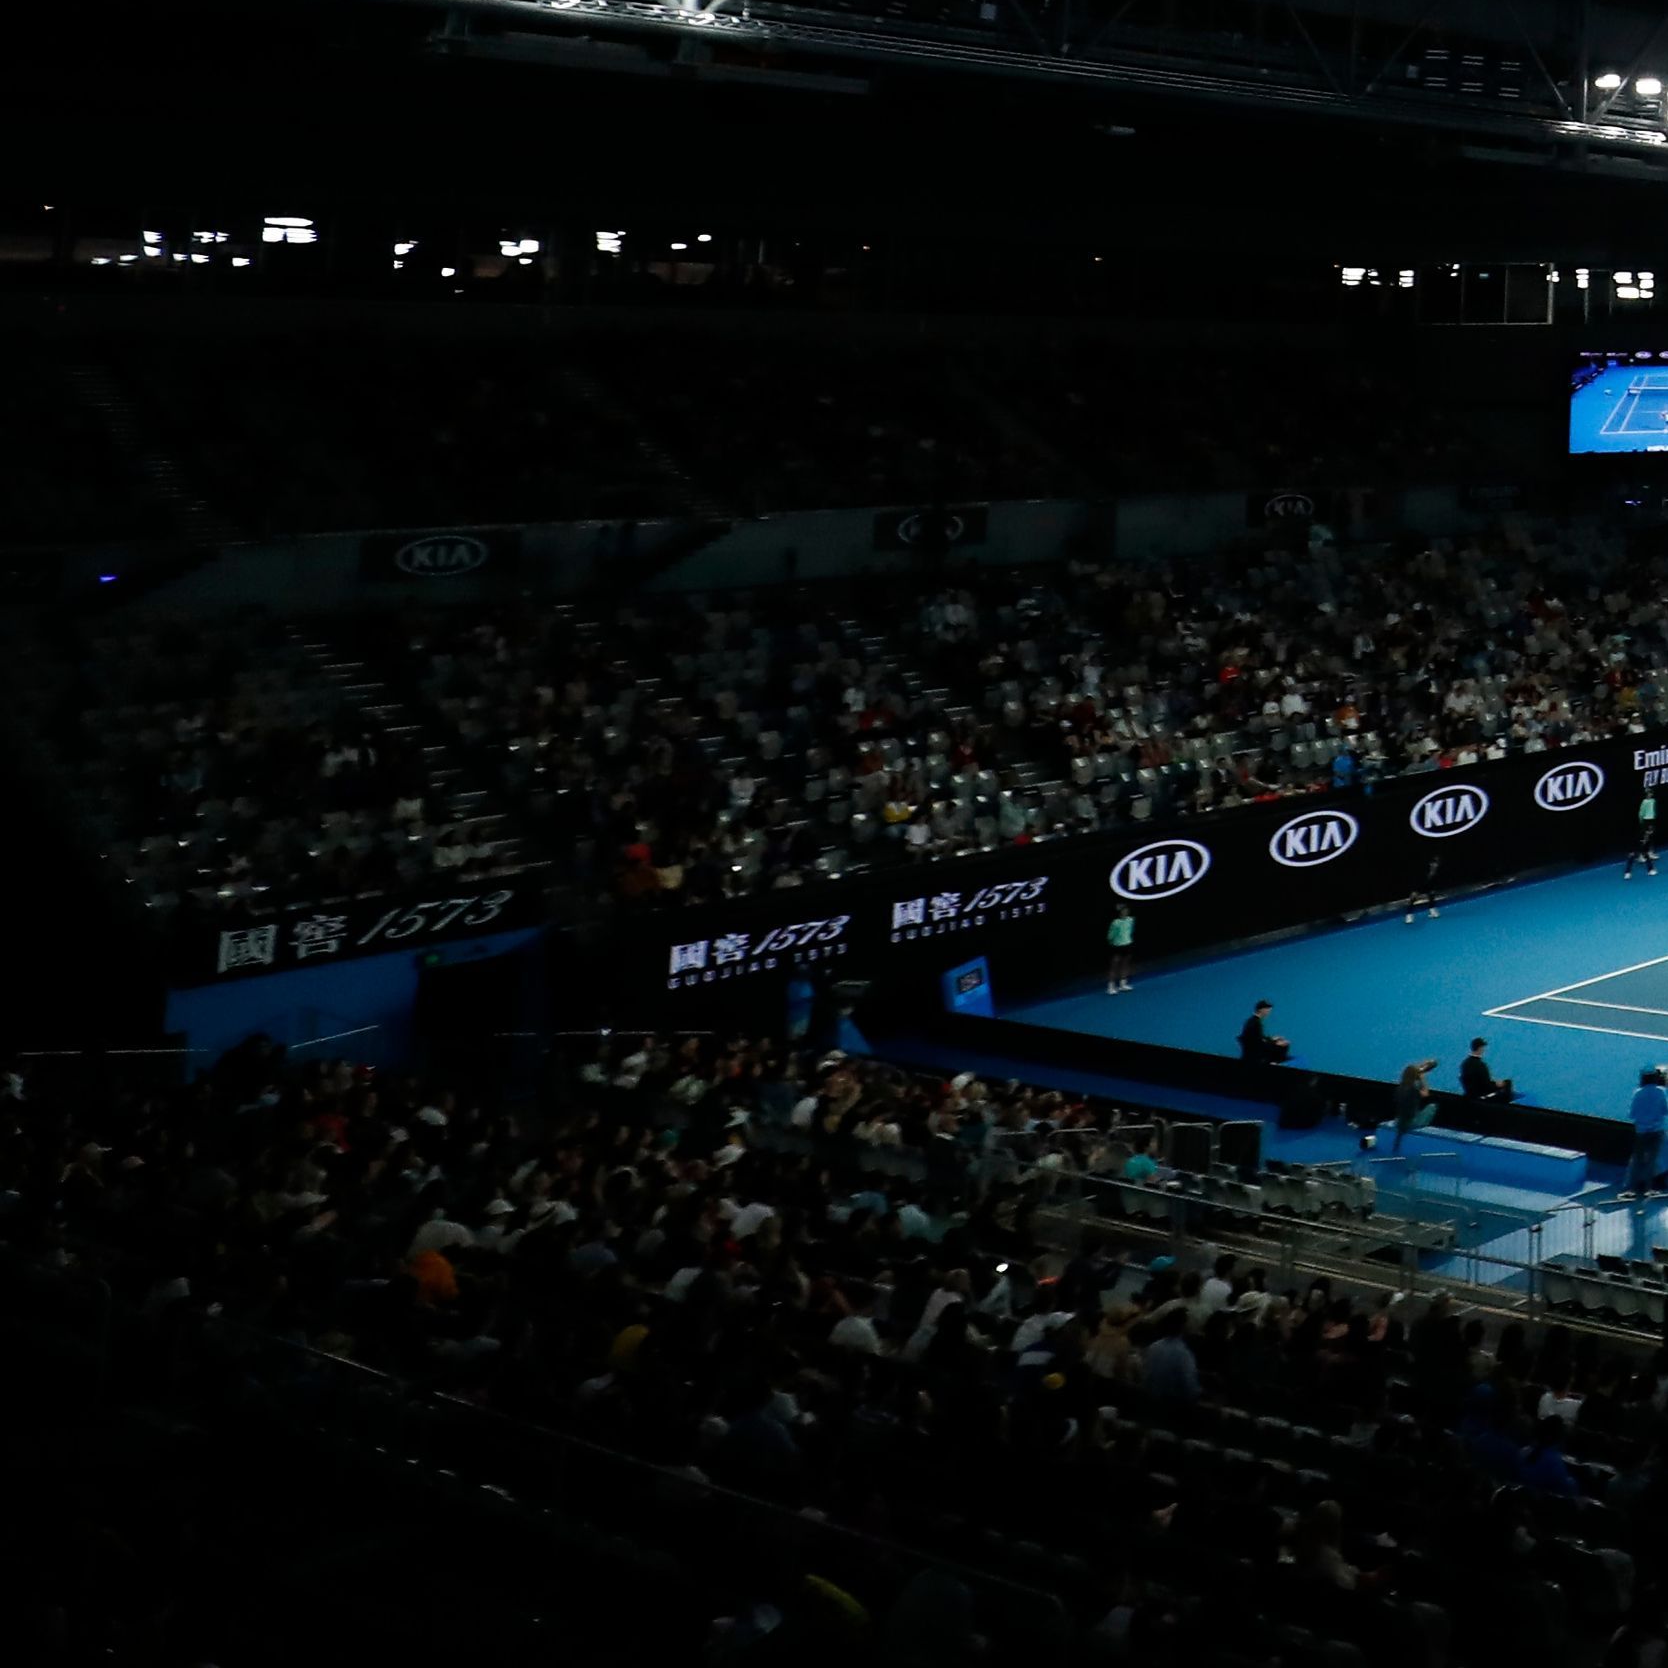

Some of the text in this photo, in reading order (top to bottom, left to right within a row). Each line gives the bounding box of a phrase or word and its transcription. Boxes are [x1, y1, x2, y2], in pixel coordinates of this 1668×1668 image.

[1545, 771, 1594, 805] KIA
[1422, 793, 1476, 830] KIA
[1284, 819, 1346, 858] KIA
[1125, 860, 1192, 893] KIA
